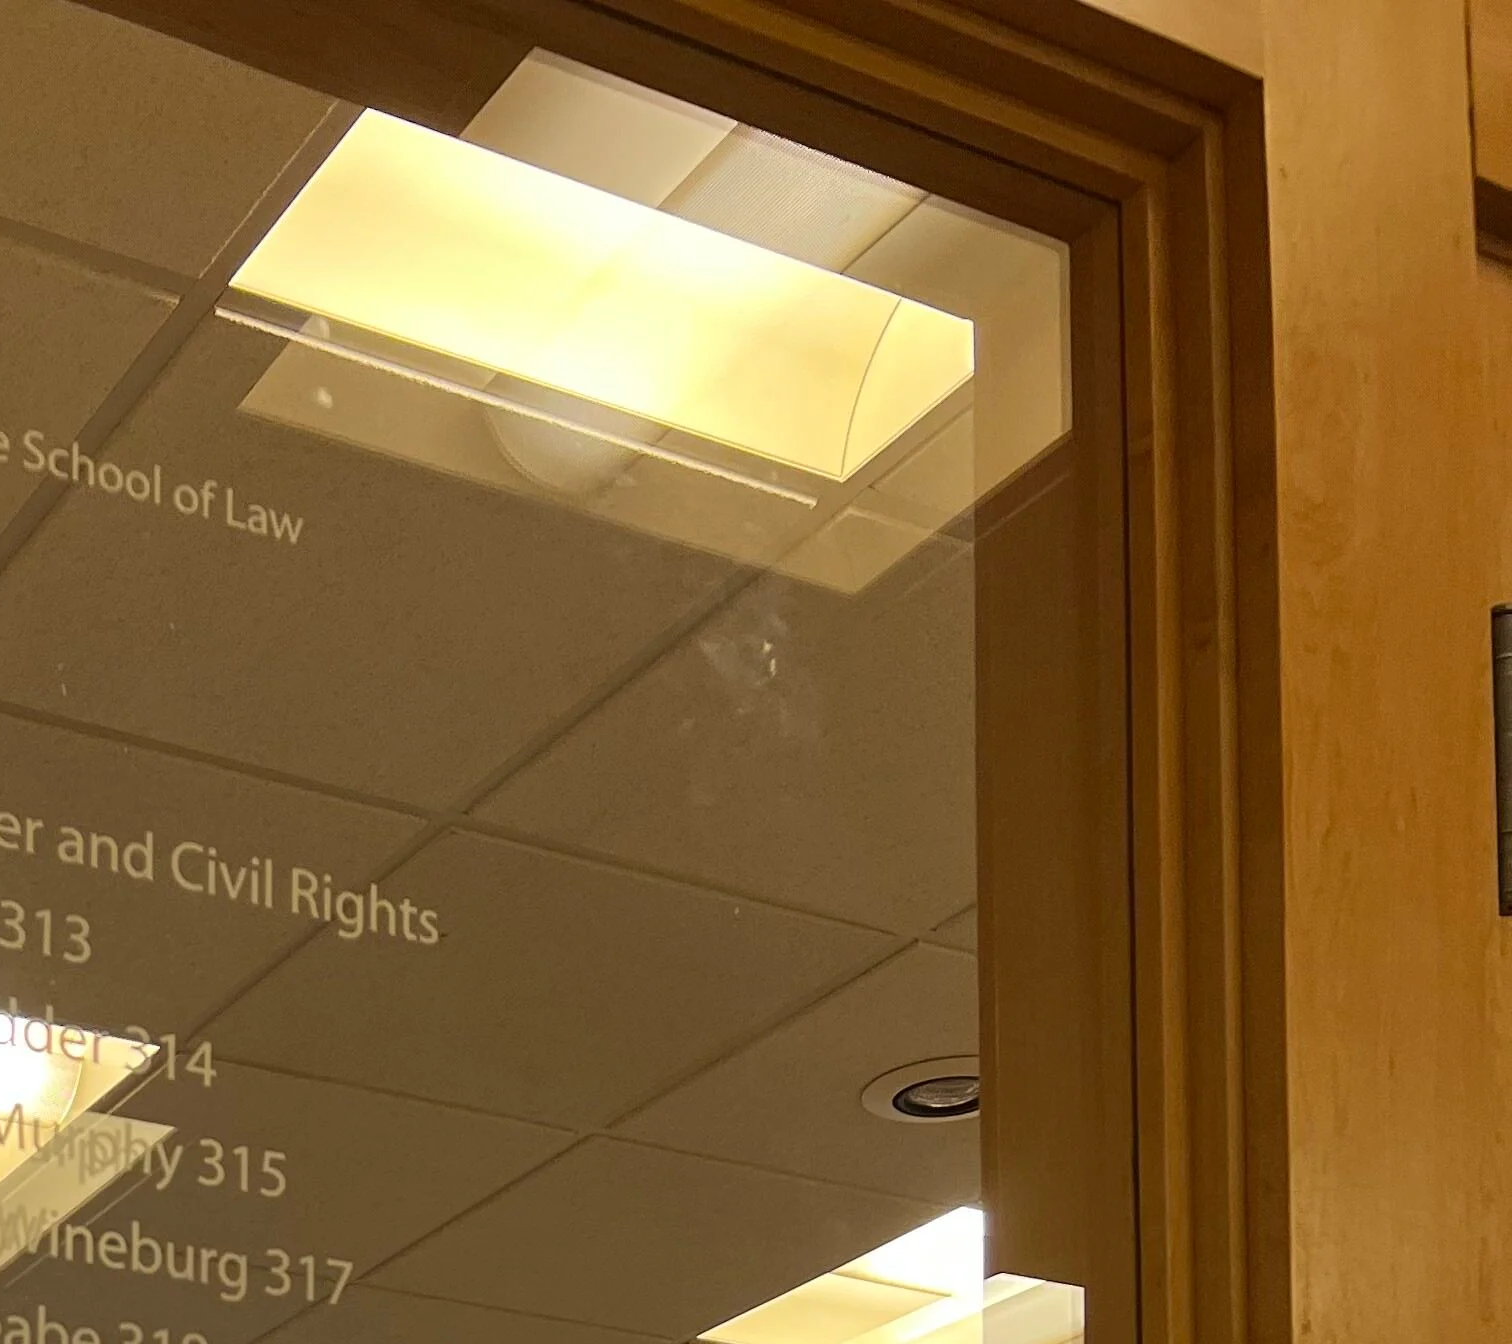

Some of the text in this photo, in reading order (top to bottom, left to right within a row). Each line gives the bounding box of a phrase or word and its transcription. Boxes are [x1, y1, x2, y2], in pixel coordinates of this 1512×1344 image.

[23, 431, 162, 505] School
[173, 480, 216, 519] of
[227, 489, 304, 544] Law
[57, 832, 153, 880] and
[171, 843, 273, 908] Civil
[292, 868, 441, 943] Rights
[124, 1025, 217, 1087] 314
[197, 1139, 287, 1197] 315
[265, 1249, 353, 1305] 317
